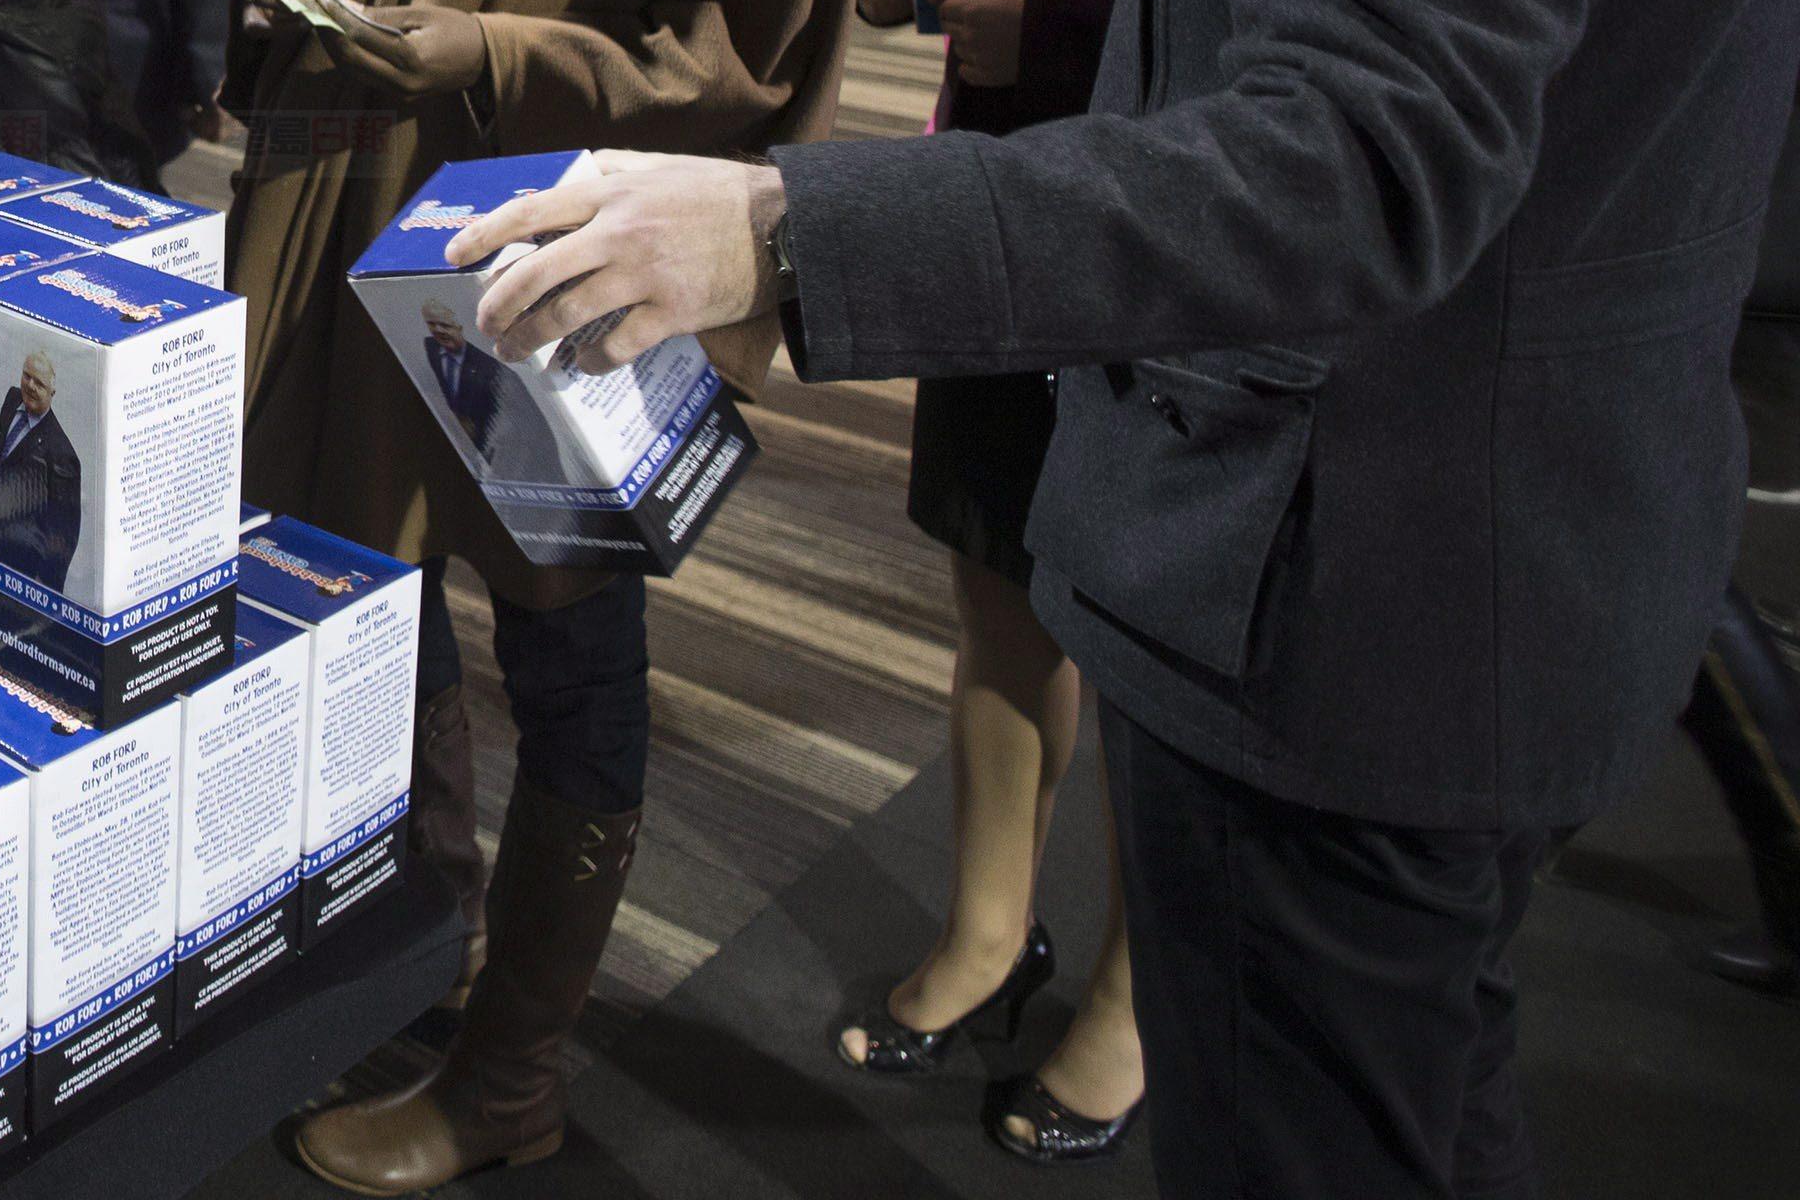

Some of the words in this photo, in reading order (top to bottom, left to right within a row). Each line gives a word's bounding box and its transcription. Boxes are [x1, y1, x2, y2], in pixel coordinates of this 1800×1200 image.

[152, 242, 167, 258] ROB
[169, 237, 189, 252] FORD
[162, 259, 169, 271] of
[172, 251, 199, 266] Toronto
[152, 358, 170, 377] City
[173, 353, 181, 369] of
[184, 340, 215, 364] Toronto
[162, 337, 179, 355] ROB
[182, 327, 204, 347] FORD
[5, 574, 23, 594] ROB
[26, 586, 49, 607] FORD
[179, 579, 197, 603] ROB
[199, 568, 221, 593] FORD
[62, 603, 80, 624] ROB
[84, 616, 109, 638] FORD
[122, 606, 142, 630] ROB
[144, 594, 168, 620] FORD
[131, 639, 146, 656] THIS
[147, 623, 178, 648] PRODUCT
[179, 620, 185, 632] IS
[186, 613, 199, 628] NOT
[200, 610, 205, 621] A
[205, 604, 218, 619] TOY.
[348, 628, 362, 647] City
[364, 623, 370, 637] of
[373, 608, 397, 632] Toronto
[356, 609, 370, 627] ROB
[371, 599, 388, 618] FORD
[139, 647, 152, 663] FOR
[153, 633, 179, 655] DISPLAY
[180, 627, 192, 642] USE
[193, 618, 210, 635] ONLY.
[121, 685, 139, 703] POUR
[139, 662, 184, 693] PRESENTATION
[184, 642, 223, 670] UNIQUEMENT.
[125, 678, 133, 691] CE
[134, 664, 162, 687] PRODUIT
[162, 655, 179, 672] N'EST
[180, 649, 191, 663] PAS
[192, 644, 201, 657] UN
[202, 634, 220, 652] JOUET.
[233, 677, 248, 696] ROB
[251, 665, 270, 686] FORD
[224, 697, 240, 717] City
[242, 691, 250, 706] of
[253, 674, 280, 700] Toronto
[82, 773, 101, 794] City
[104, 767, 112, 783] of
[116, 748, 148, 776] Toronto
[92, 751, 110, 772] ROB
[113, 738, 136, 761] FORD
[247, 889, 263, 913] ROB
[265, 875, 285, 902] FORD
[196, 921, 213, 946] ROB
[215, 907, 237, 934] FORD
[114, 975, 133, 1001] ROB
[135, 960, 157, 988] FORD
[54, 1011, 75, 1038] ROB
[77, 995, 102, 1024] FORD
